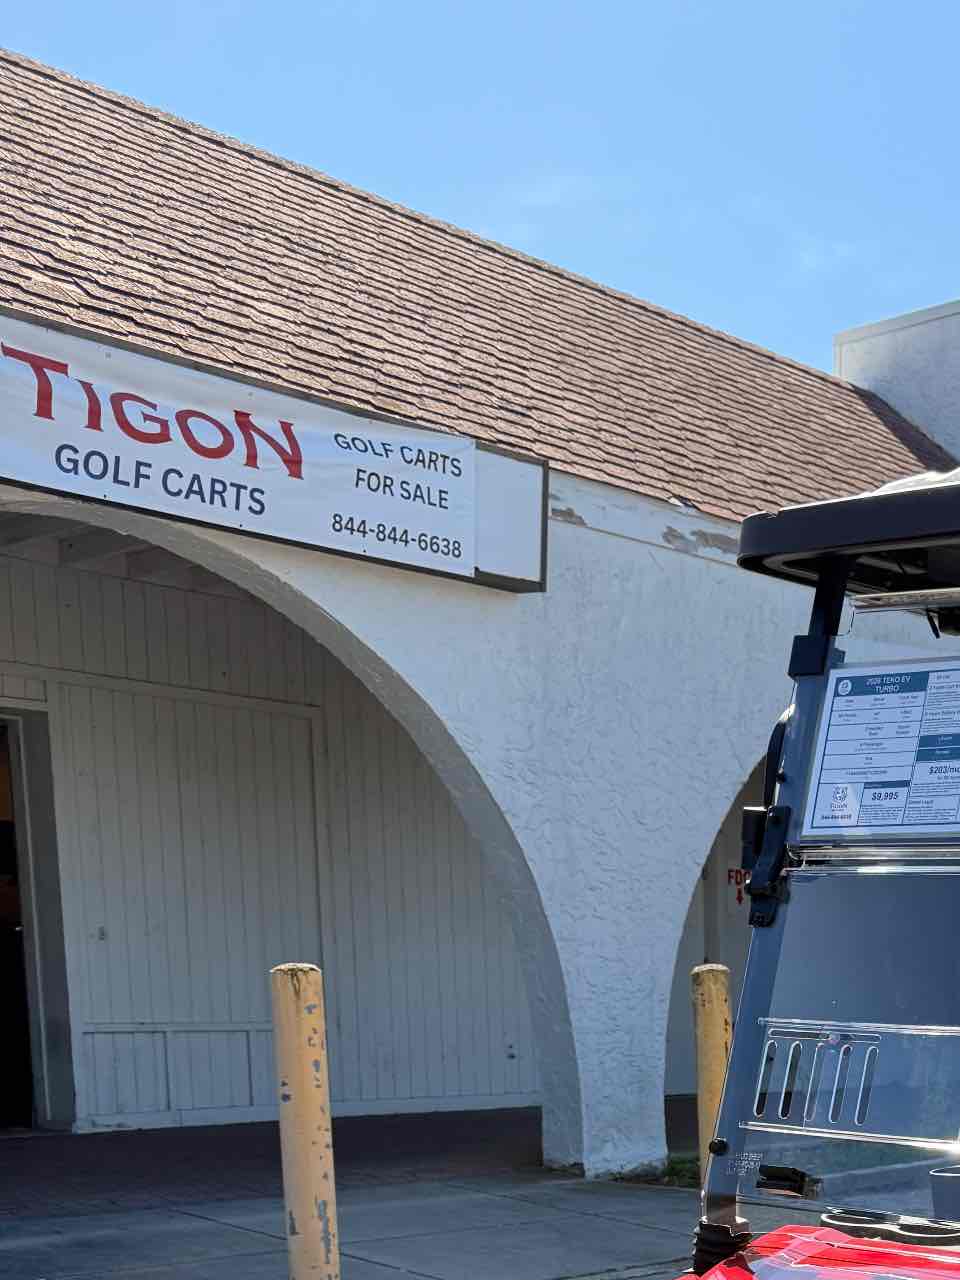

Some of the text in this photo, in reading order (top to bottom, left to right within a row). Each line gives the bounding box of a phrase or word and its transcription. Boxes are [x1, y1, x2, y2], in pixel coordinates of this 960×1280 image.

[0, 342, 304, 480] TIGON
[333, 432, 462, 478] GOLF CARTS
[54, 443, 266, 516] GOLF CARTS
[355, 468, 449, 510] FOR SALE
[332, 513, 462, 559] 844-844-6638
[871, 791, 899, 801] $9,995
